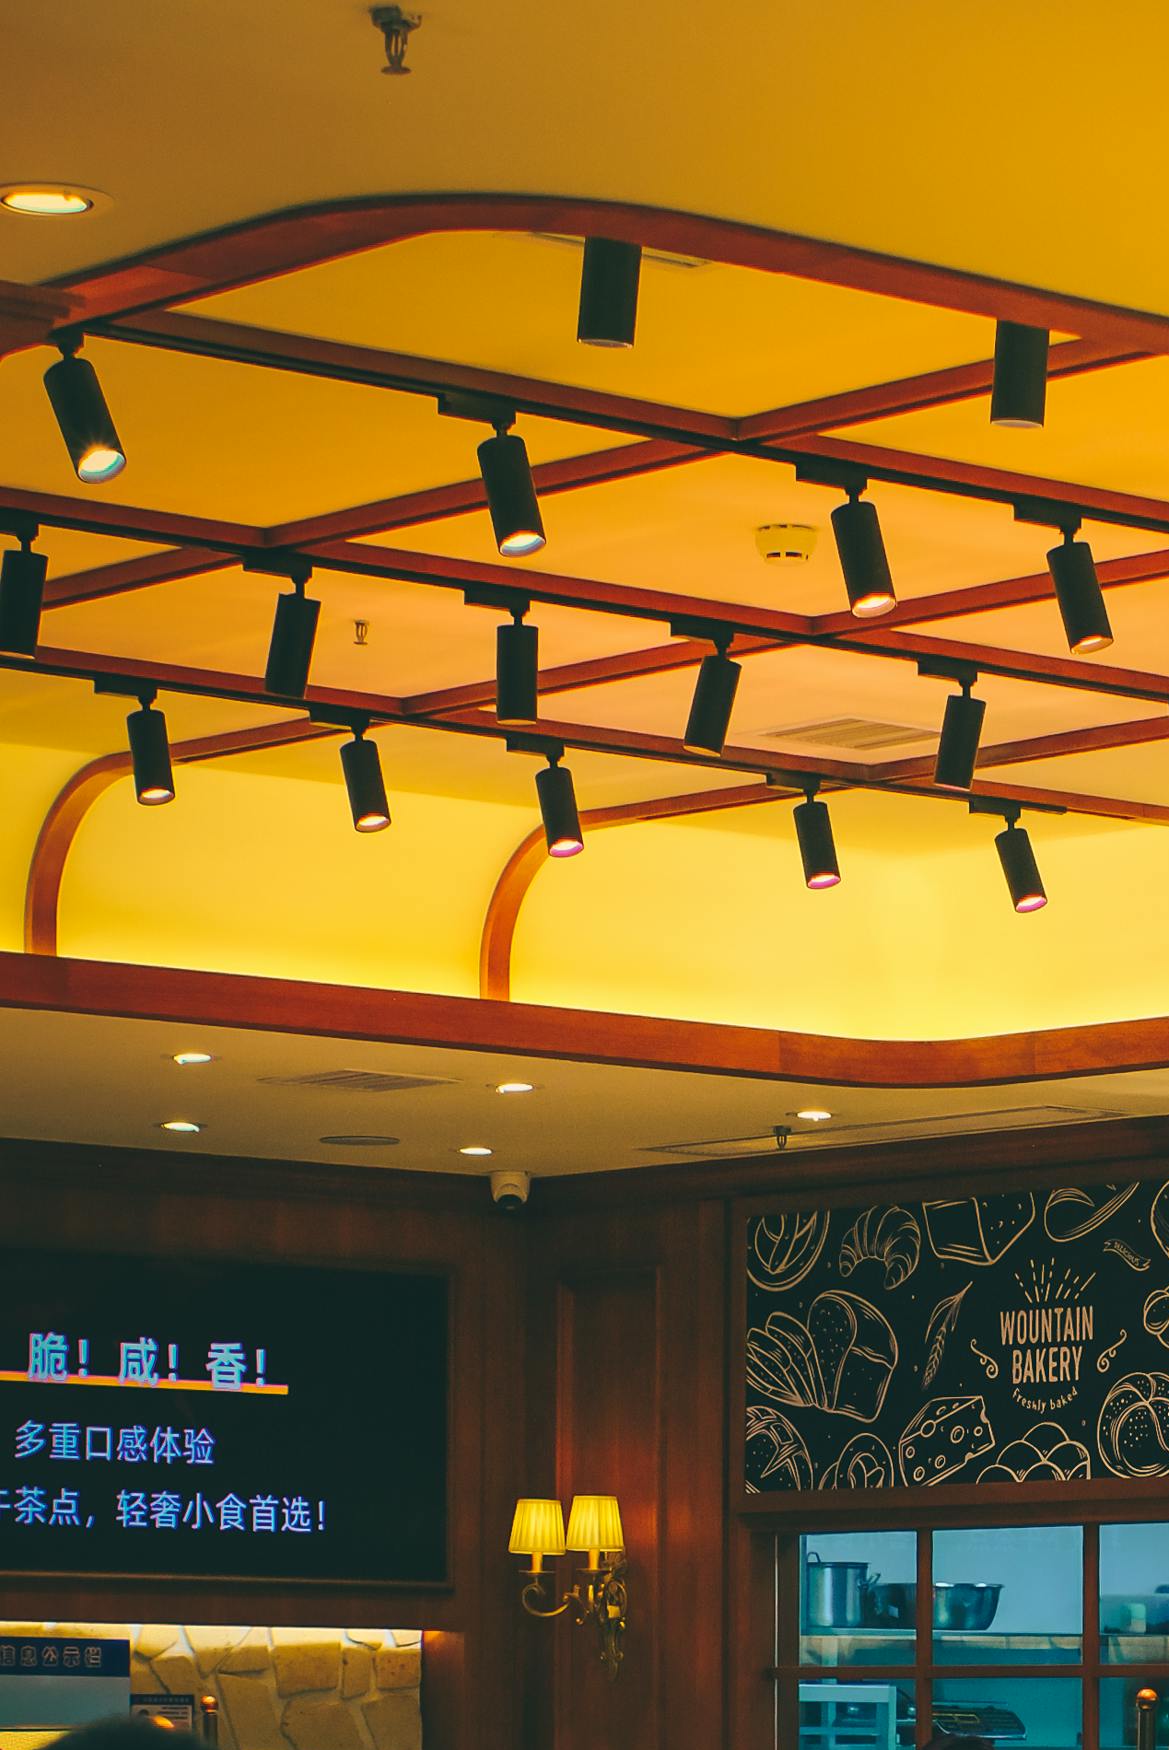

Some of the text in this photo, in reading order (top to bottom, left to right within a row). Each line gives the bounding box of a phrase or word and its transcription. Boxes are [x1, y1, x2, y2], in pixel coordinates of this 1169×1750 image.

[1000, 1305, 1094, 1346] WOUNTAIN
[1012, 1346, 1083, 1384] BAKERY
[1012, 1385, 1078, 1414] freshly baked
[14, 1420, 217, 1465] 多重口感体验
